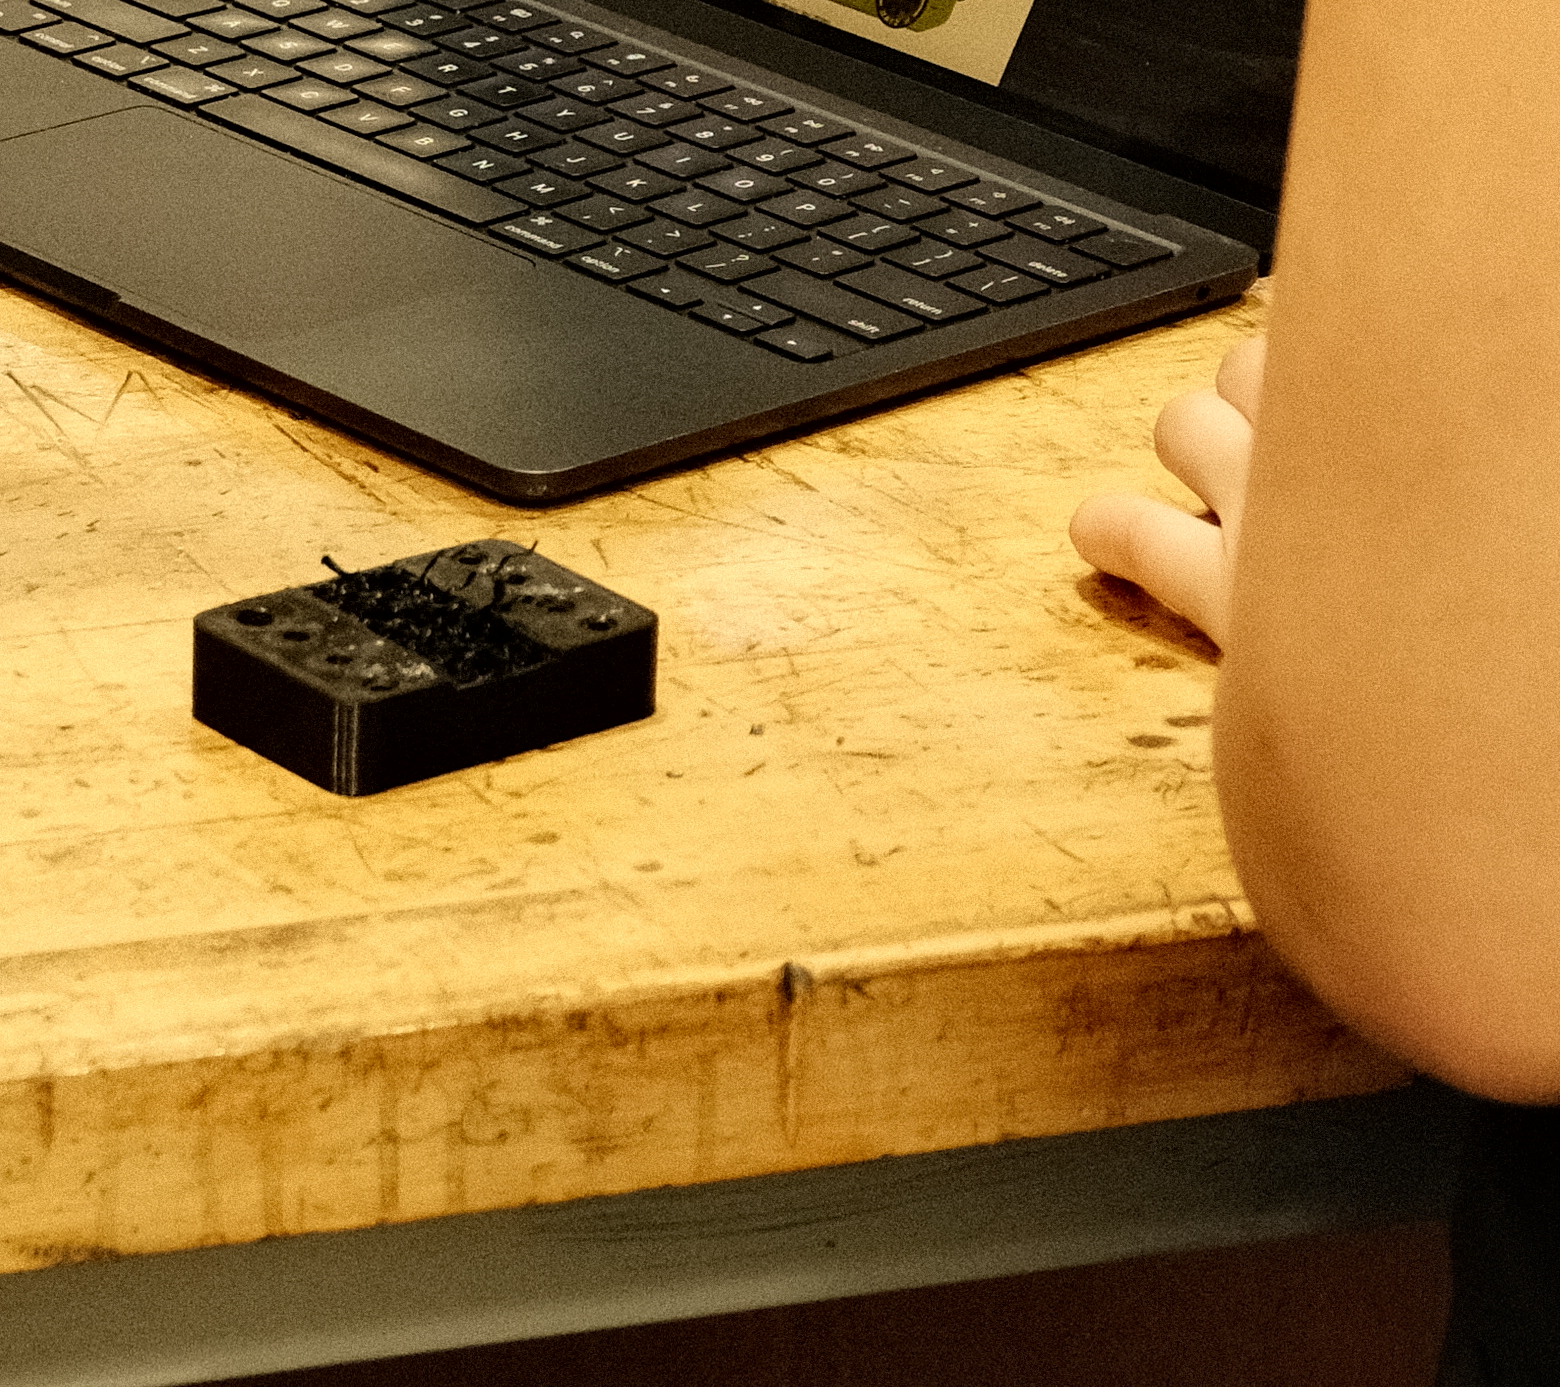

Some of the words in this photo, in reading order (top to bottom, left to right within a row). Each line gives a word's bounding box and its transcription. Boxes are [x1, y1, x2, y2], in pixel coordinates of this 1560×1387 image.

[188, 46, 209, 55] Z
[243, 68, 263, 77] X
[299, 90, 321, 99] C
[359, 113, 378, 122] V
[414, 137, 434, 146] B
[473, 159, 493, 169] N
[531, 183, 554, 194] M
[848, 319, 879, 333] shift
[224, 20, 242, 28] A
[333, 63, 354, 72] D
[448, 109, 468, 118] G
[505, 131, 527, 140] H
[566, 156, 586, 164] J
[626, 178, 645, 188] K
[687, 202, 703, 212] L
[903, 297, 942, 315] return
[326, 19, 348, 29] W
[438, 64, 458, 73] R
[498, 85, 517, 94] T
[557, 108, 574, 117] Y
[613, 131, 634, 141] U
[796, 203, 816, 211] P
[405, 18, 424, 26] 3
[519, 62, 538, 71] 5
[577, 85, 595, 93] 6
[695, 131, 714, 139] 8
[756, 154, 774, 162] 9
[1028, 261, 1067, 278] delete
[505, 225, 561, 249] command
[582, 256, 619, 273] option
